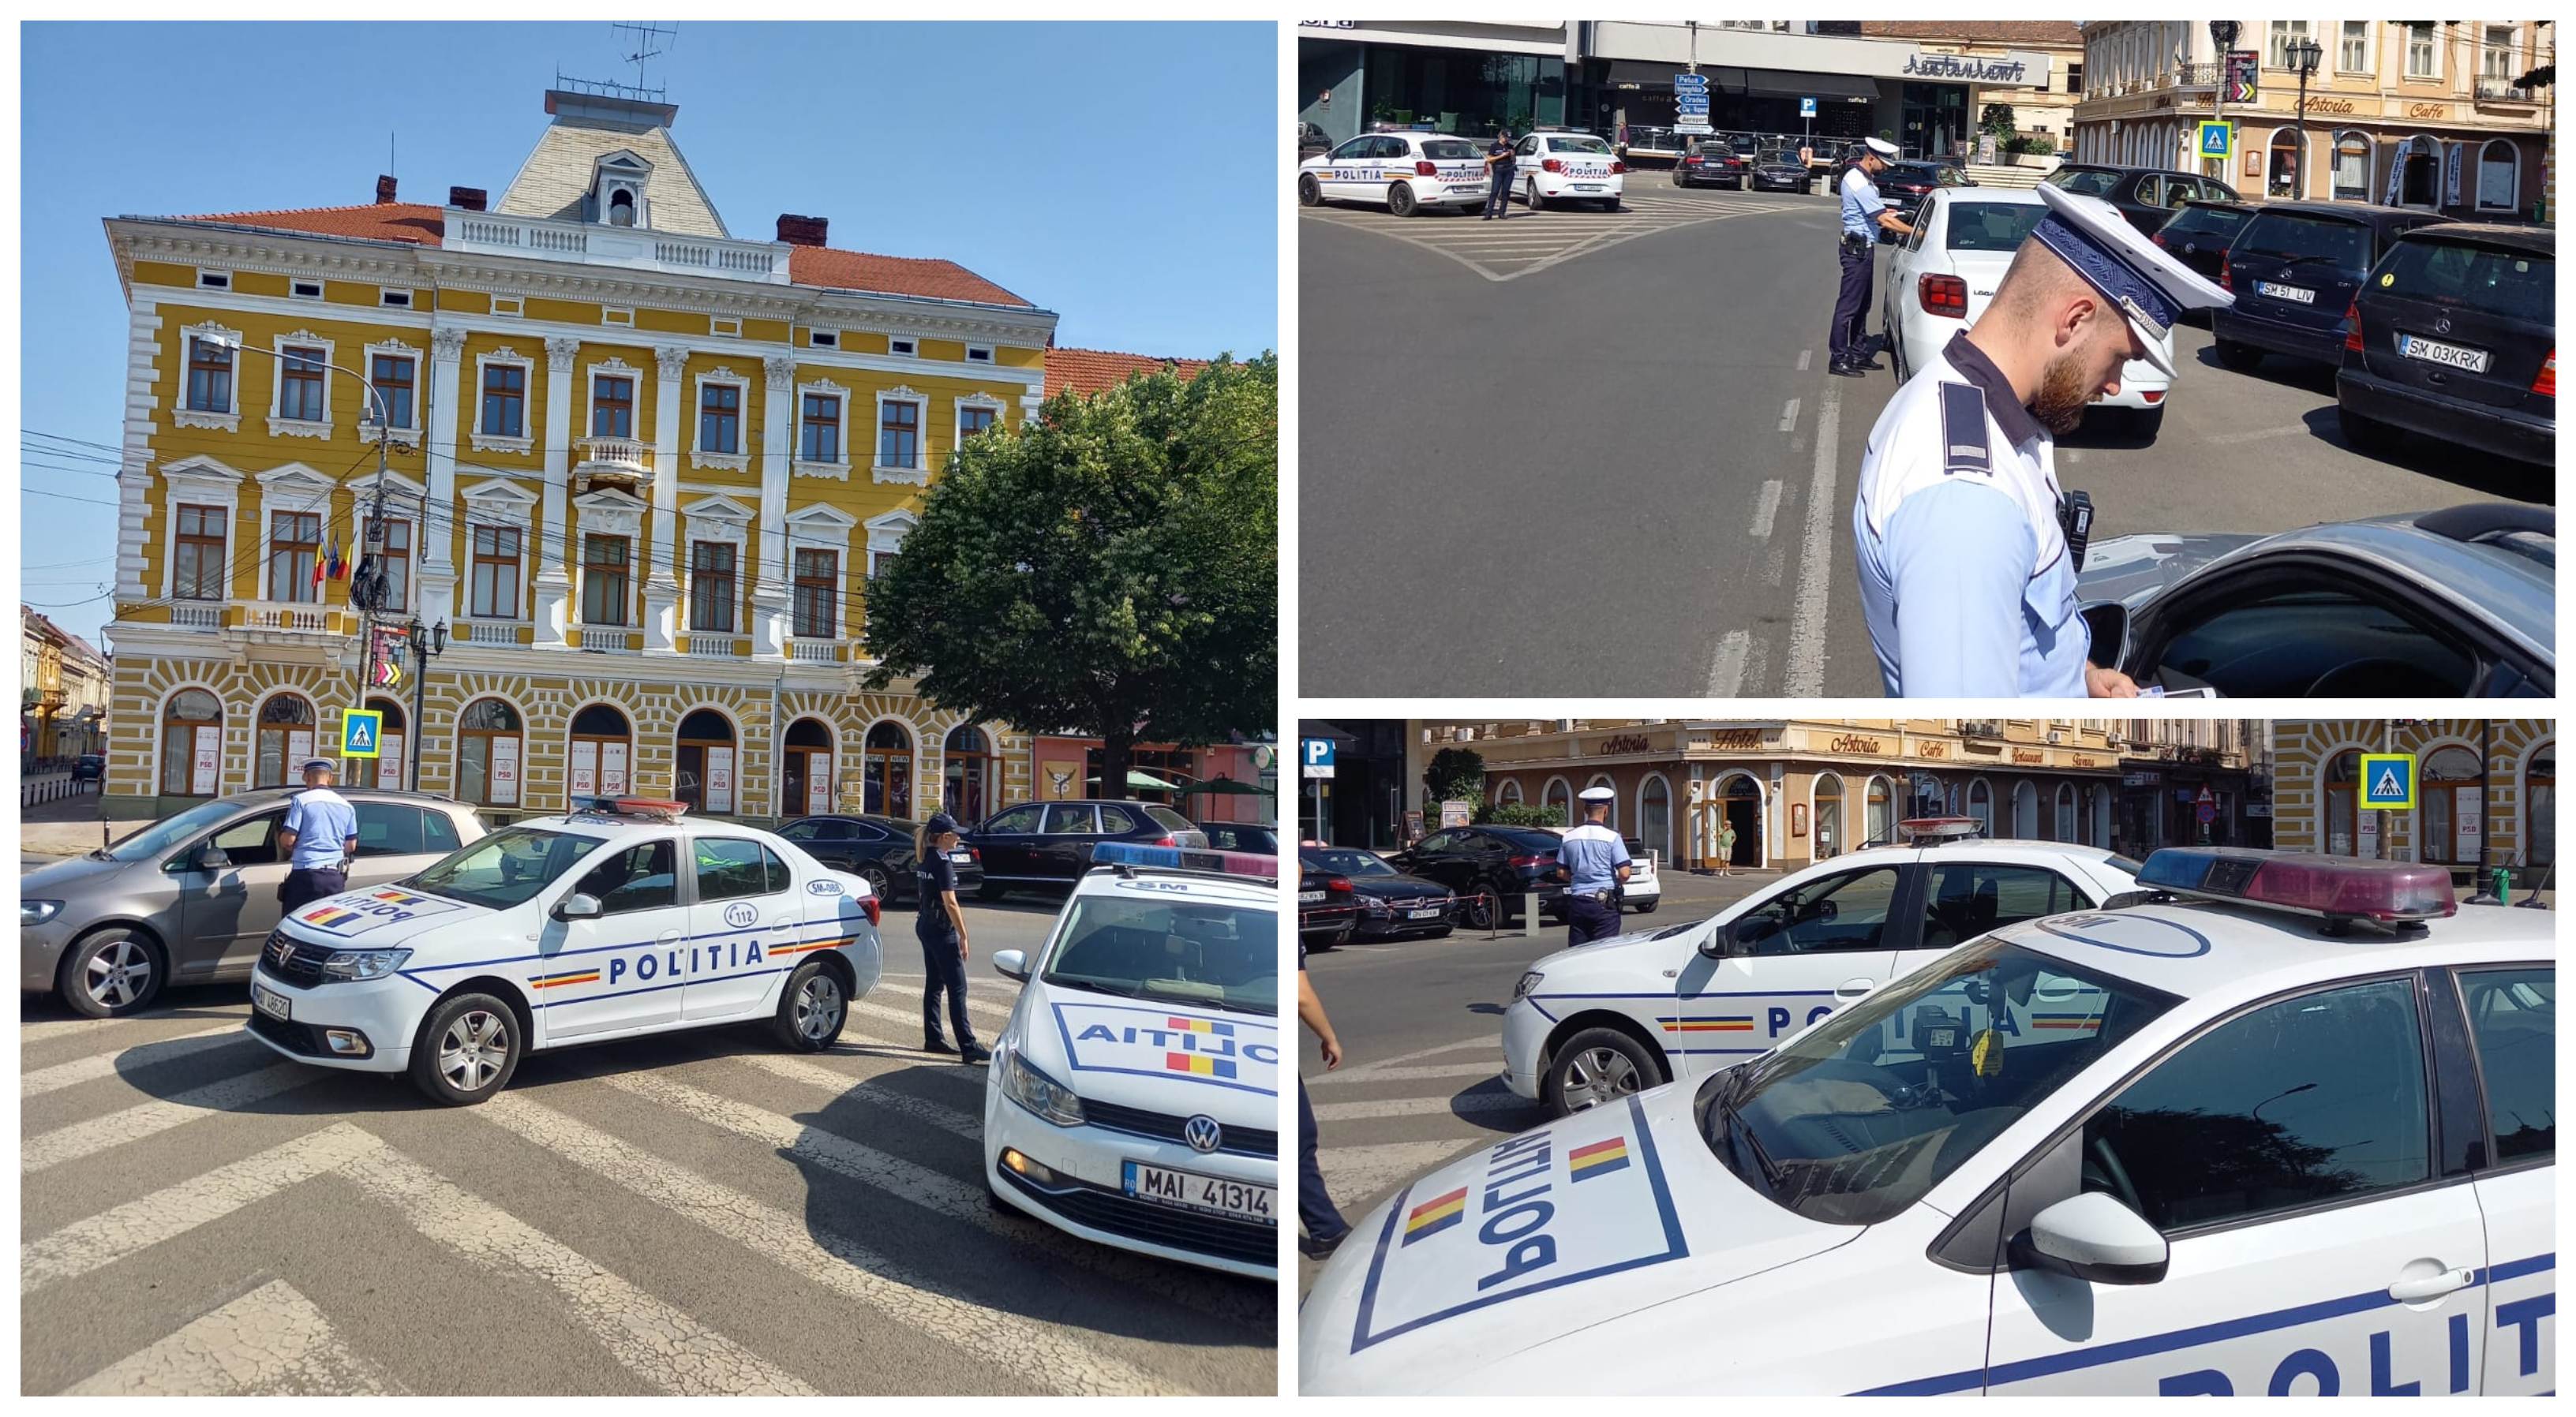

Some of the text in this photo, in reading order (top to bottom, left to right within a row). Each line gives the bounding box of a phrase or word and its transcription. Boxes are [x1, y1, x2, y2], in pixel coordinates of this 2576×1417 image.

[1803, 99, 1814, 109] P
[2293, 95, 2354, 114] Astoria
[1335, 170, 1382, 180] POLITIA
[2265, 282, 2313, 301] SM 51 LIV
[2409, 340, 2428, 355] SM
[1601, 734, 1649, 754] Astoria
[1711, 728, 1760, 749] Hotel
[1831, 734, 1881, 754] Astoria
[1309, 740, 1328, 764] P
[1136, 882, 1188, 891] SM
[736, 910, 753, 924] 112
[610, 940, 763, 985] POLITIA
[1145, 1168, 1184, 1199] MAI
[1202, 1180, 1269, 1215] 41314
